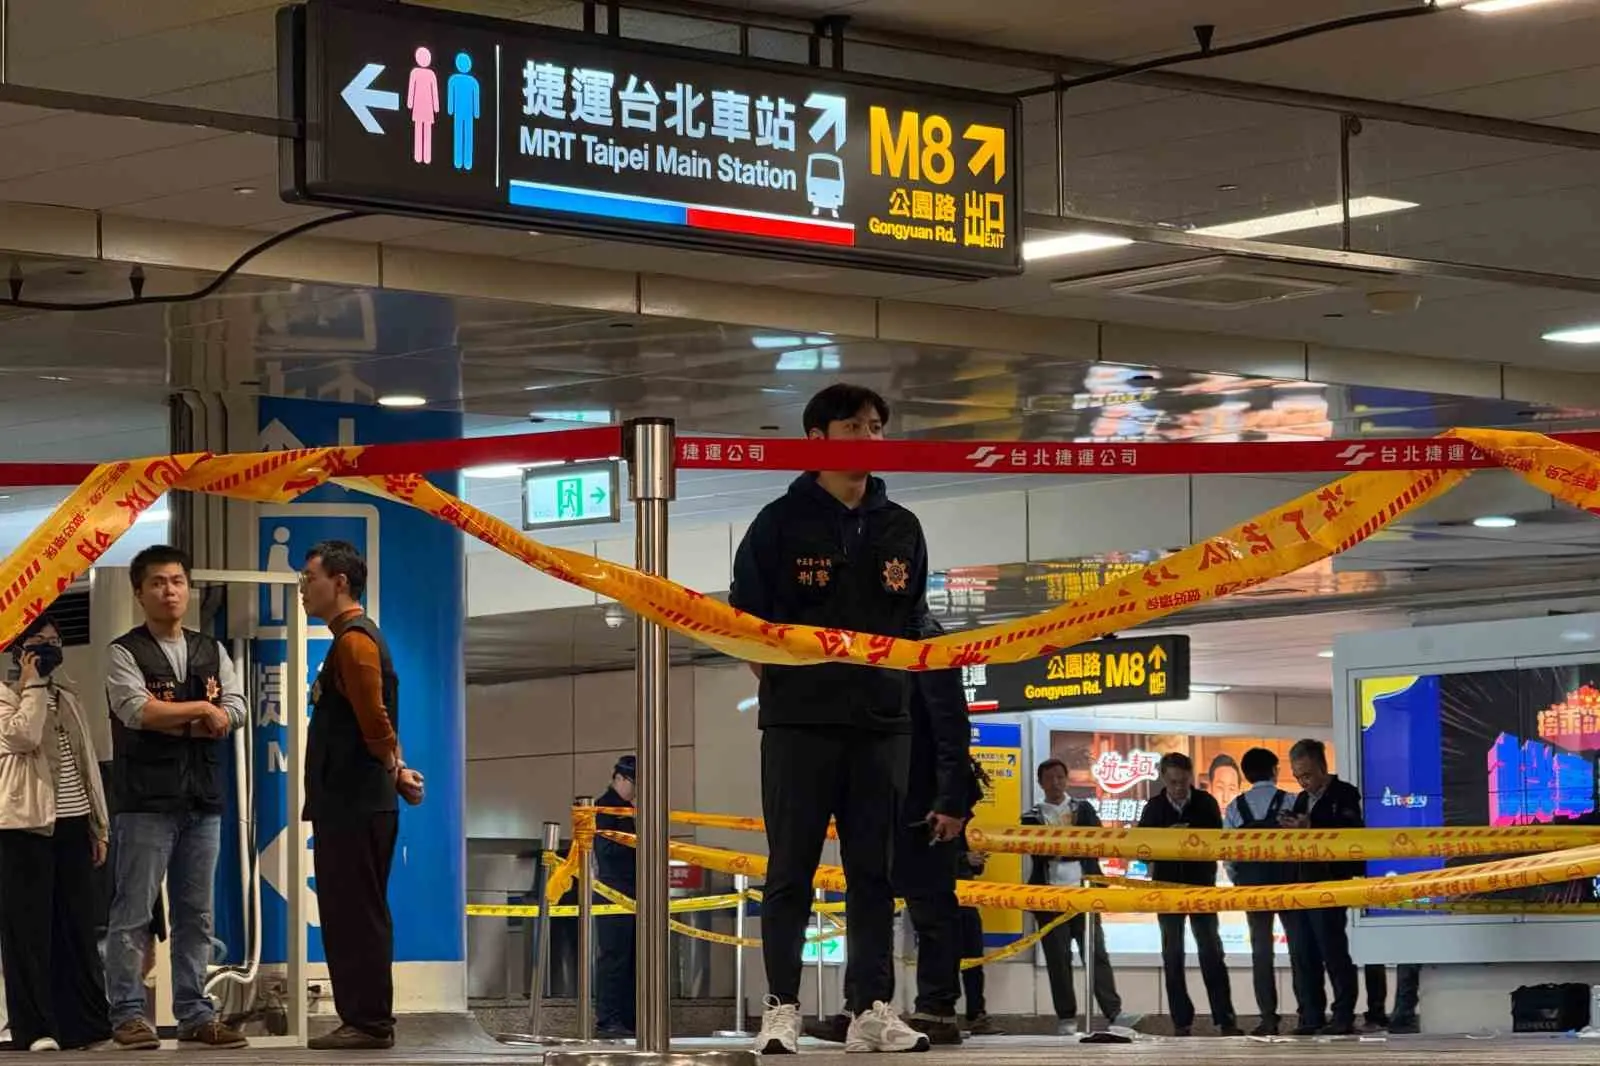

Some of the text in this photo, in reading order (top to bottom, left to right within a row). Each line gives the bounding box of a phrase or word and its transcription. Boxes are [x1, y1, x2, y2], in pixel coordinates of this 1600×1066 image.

[521, 59, 796, 151] 捷運台北車站
[520, 126, 796, 191] MRT Taipei Main Station
[869, 105, 955, 185] M8
[889, 188, 957, 223] 公園路
[964, 190, 1005, 248] 出口
[868, 217, 957, 243] Gongyuan Rd.
[985, 232, 1005, 248] EXIT
[1010, 448, 1137, 467] 台北捷運公司
[797, 570, 830, 587] 刑警
[1047, 652, 1101, 680] 公園路
[1105, 652, 1145, 688] M8
[1025, 681, 1102, 700] Gongyuan Rd.
